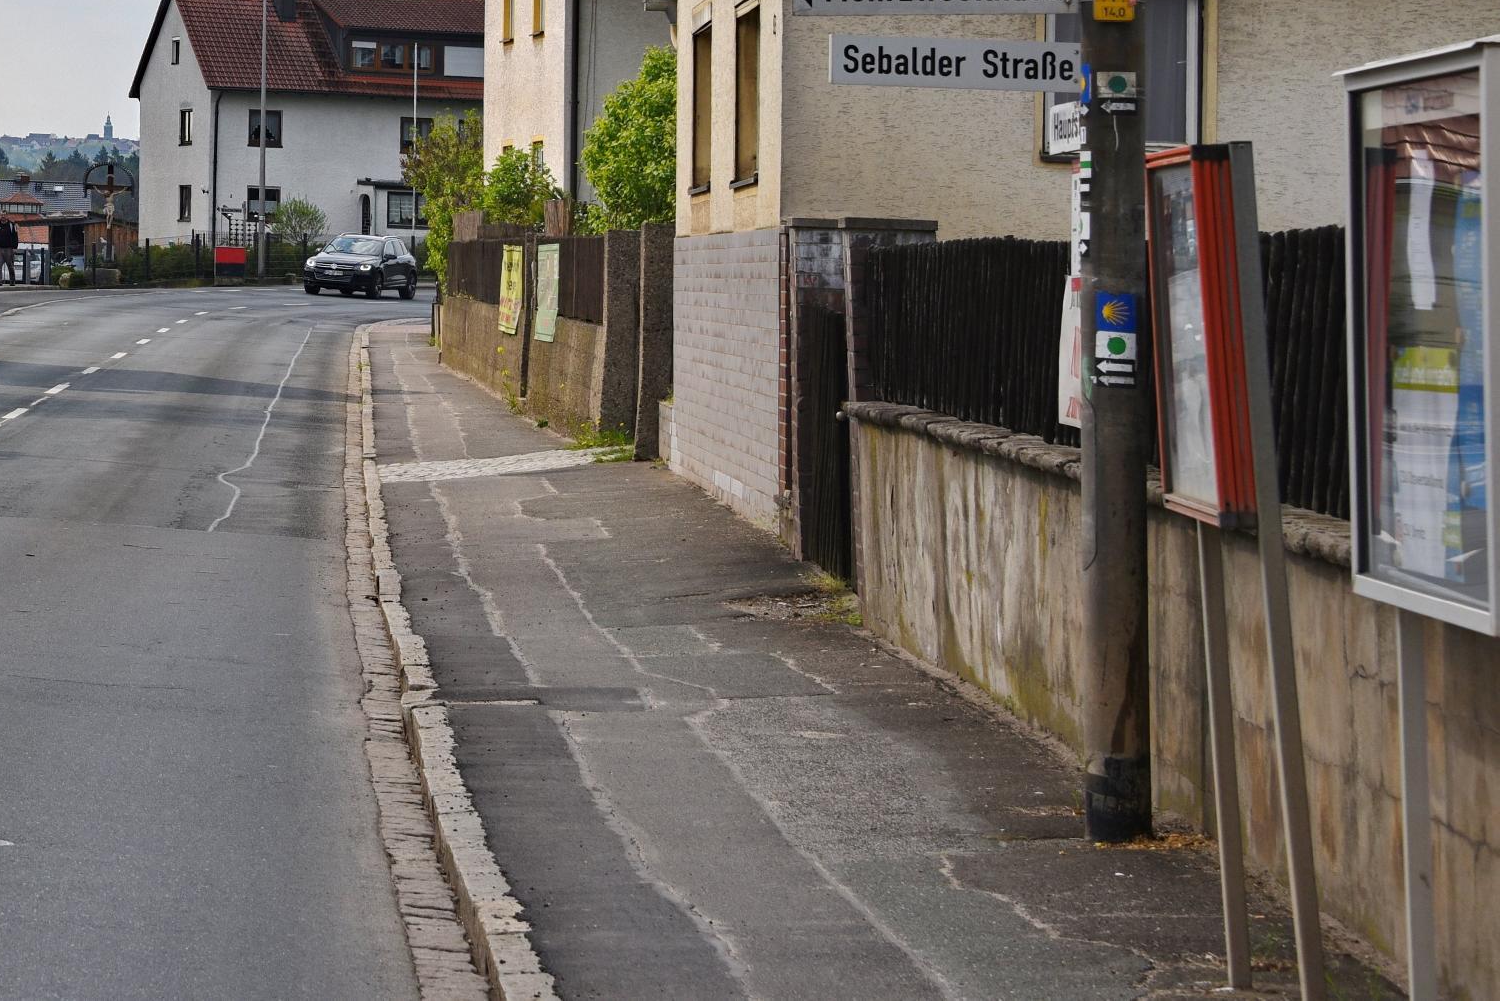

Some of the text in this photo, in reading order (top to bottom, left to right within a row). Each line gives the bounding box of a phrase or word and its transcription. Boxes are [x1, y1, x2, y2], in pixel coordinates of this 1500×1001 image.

[843, 44, 1075, 81] Sebalder Straße
[1053, 112, 1081, 144] Haupts
